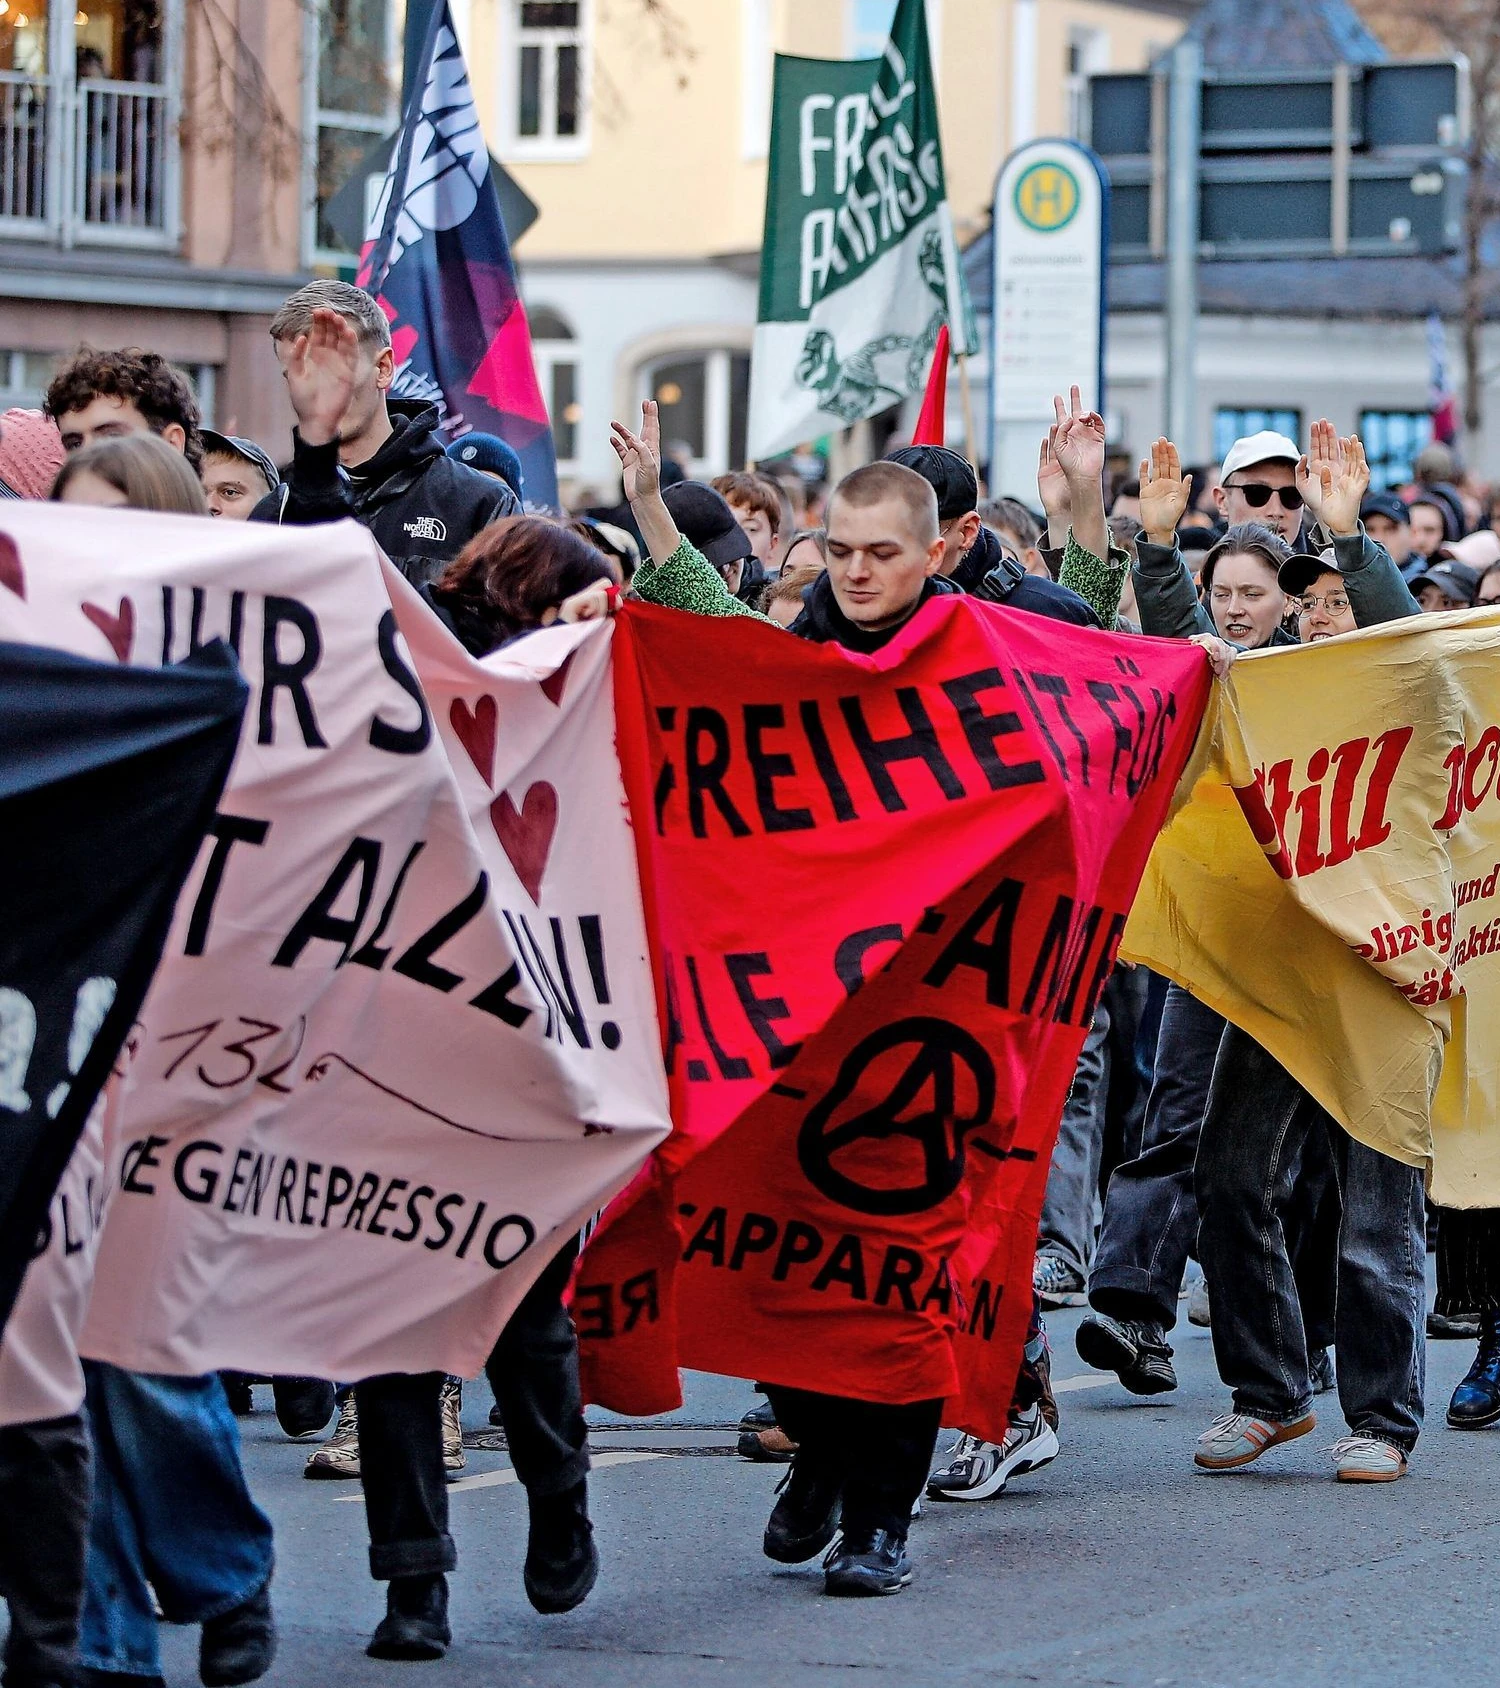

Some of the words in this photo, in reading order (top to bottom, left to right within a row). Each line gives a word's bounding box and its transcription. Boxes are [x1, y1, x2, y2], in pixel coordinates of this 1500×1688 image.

[417, 516, 434, 525] THE
[403, 522, 433, 532] NORTH
[410, 530, 432, 538] FACE
[654, 666, 1090, 840] FREIHEIT
[275, 1155, 537, 1271] REPRESSIO
